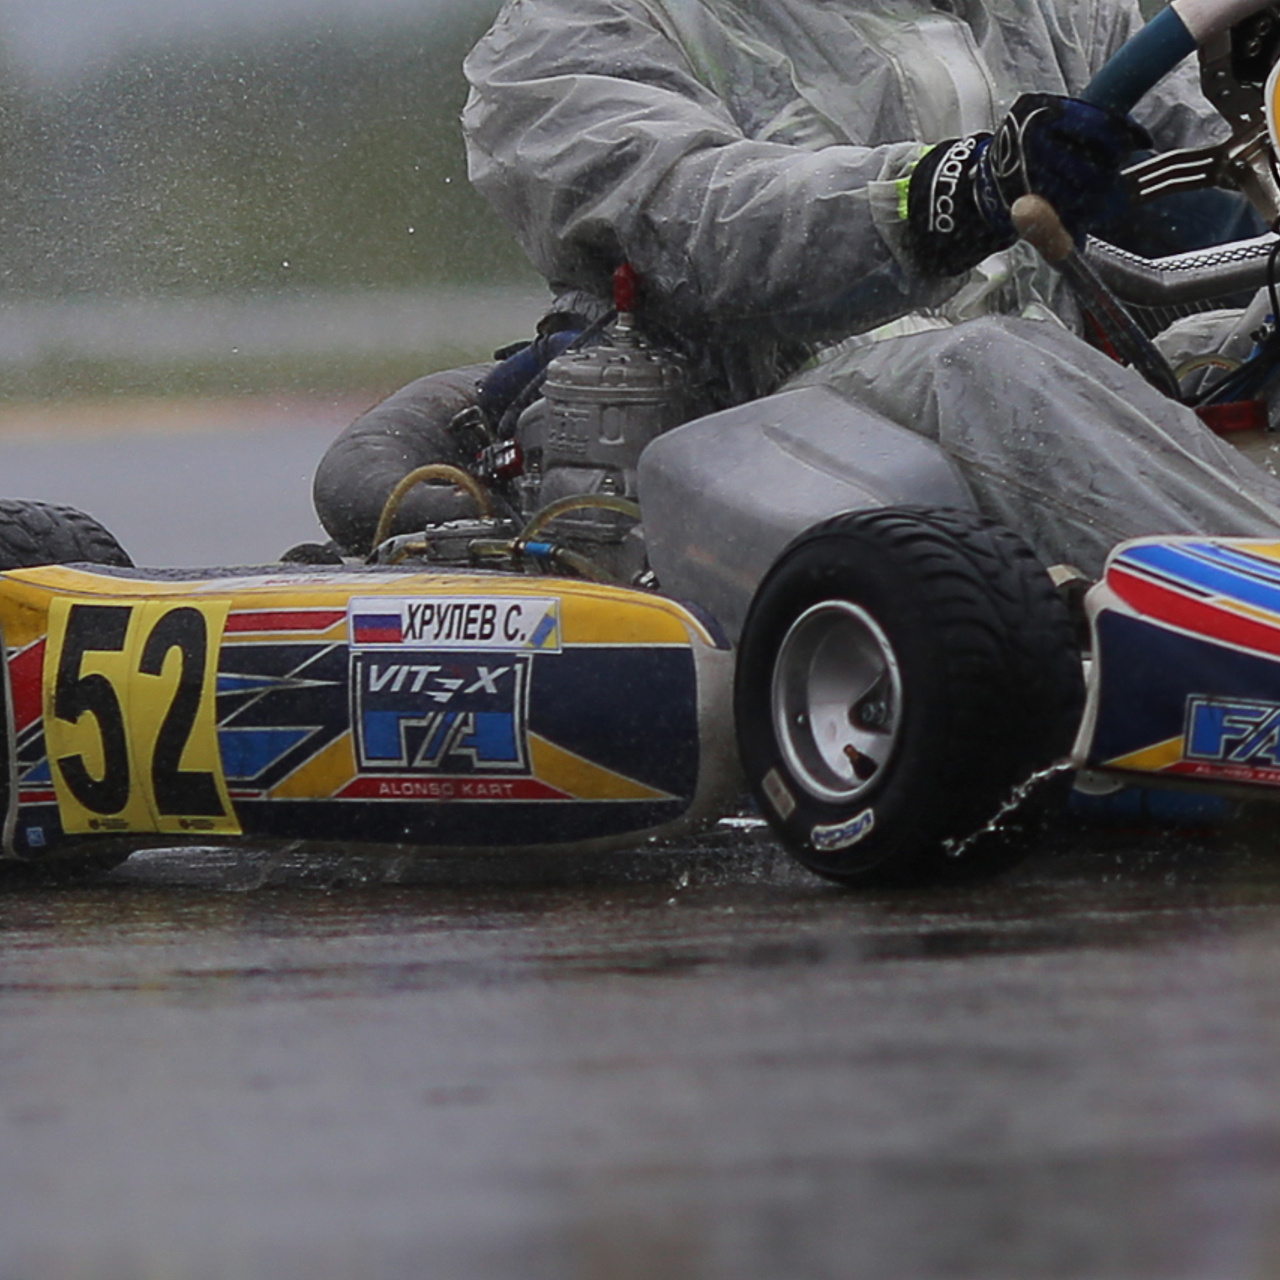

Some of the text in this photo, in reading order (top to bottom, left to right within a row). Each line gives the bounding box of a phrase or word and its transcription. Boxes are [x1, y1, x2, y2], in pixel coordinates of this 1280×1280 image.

[403, 603, 497, 641] ХРУЛЕВ
[54, 604, 228, 817] 52
[378, 782, 515, 797] ALONSO KART
